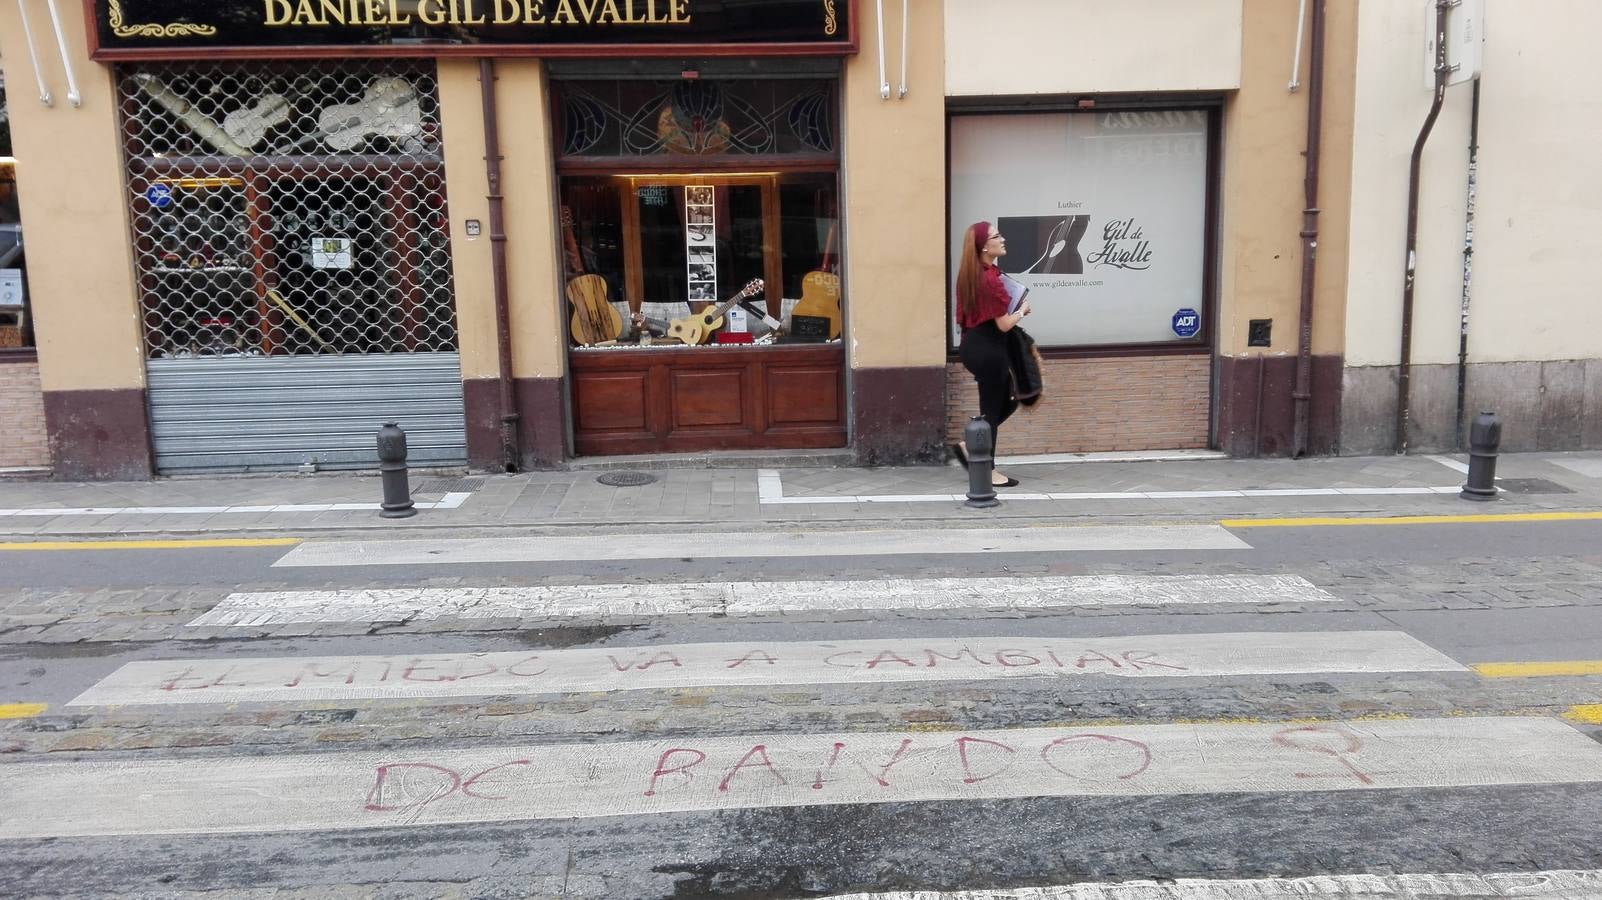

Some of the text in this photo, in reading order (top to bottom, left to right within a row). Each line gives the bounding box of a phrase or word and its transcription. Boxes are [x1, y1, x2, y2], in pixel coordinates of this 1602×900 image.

[264, 0, 692, 25] DANIEL GIL DE AVALLE
[1057, 201, 1083, 209] Luthier
[1103, 217, 1143, 248] Gil de
[1086, 240, 1153, 268] Avalle
[1032, 279, 1104, 289] www.gildeavalle.com
[1176, 316, 1196, 327] ADT
[606, 650, 683, 672] VA
[725, 649, 780, 669] A
[823, 645, 1189, 671] CAMBIAR
